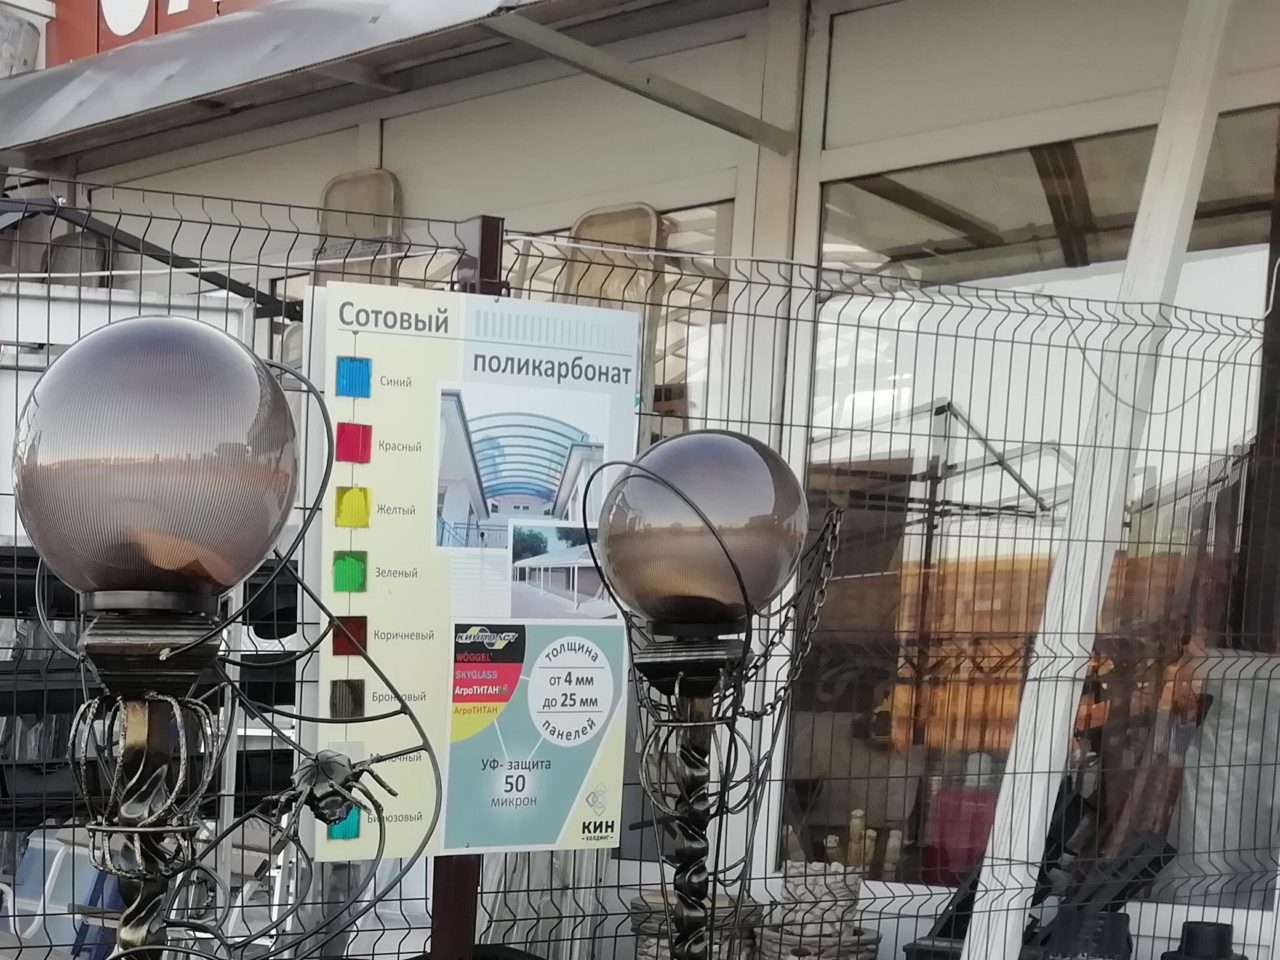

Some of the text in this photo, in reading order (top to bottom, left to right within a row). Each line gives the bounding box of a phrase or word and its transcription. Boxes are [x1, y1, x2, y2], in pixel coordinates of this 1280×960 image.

[338, 301, 449, 334] Сотовый
[473, 352, 632, 385] поликарбонат
[380, 375, 412, 388] Синий
[378, 439, 422, 453] Красный
[376, 504, 416, 516] Желтый
[375, 566, 418, 578] Зеленый
[373, 629, 435, 642] Коричневый
[544, 641, 599, 663] толщина
[455, 670, 497, 679] SKYGLASS
[549, 671, 594, 686] от 4 мм
[372, 691, 426, 704] Броновый
[542, 693, 598, 710] до 25 мм
[454, 706, 498, 715] АгроТИТАН
[542, 717, 597, 741] панелей
[507, 759, 552, 772] защита
[504, 774, 526, 793] 50
[490, 796, 537, 809] микрон
[367, 811, 423, 823] Биюзовый
[582, 820, 615, 834] КИН
